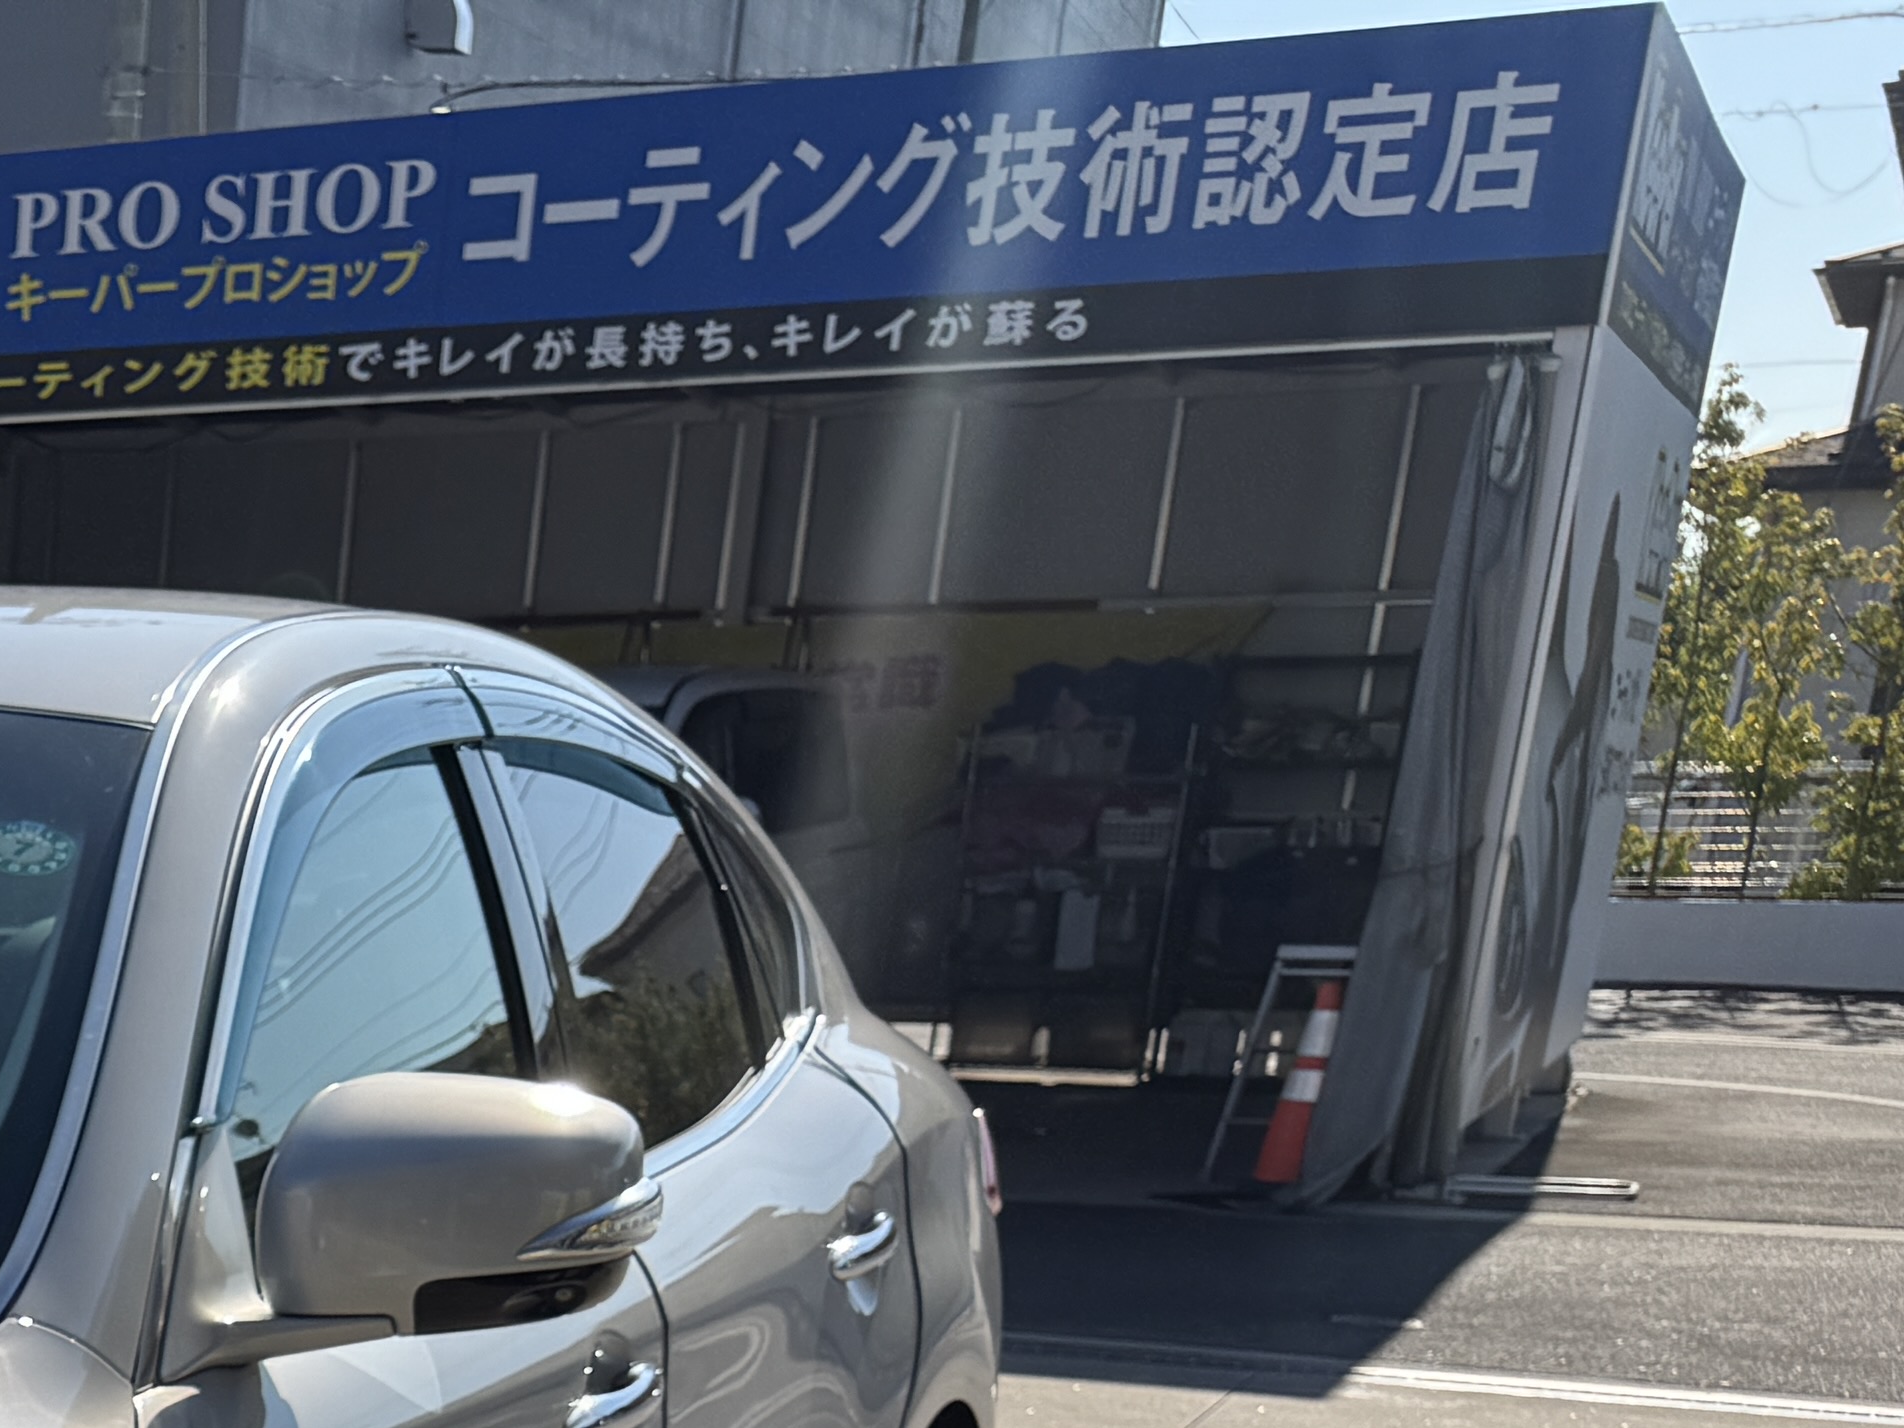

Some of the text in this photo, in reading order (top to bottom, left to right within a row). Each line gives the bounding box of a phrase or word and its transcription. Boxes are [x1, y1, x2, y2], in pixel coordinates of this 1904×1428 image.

[9, 159, 438, 259] PRO SHOP
[462, 70, 1562, 270] コーティング技術認定店
[5, 240, 430, 322] キーパープロショップ
